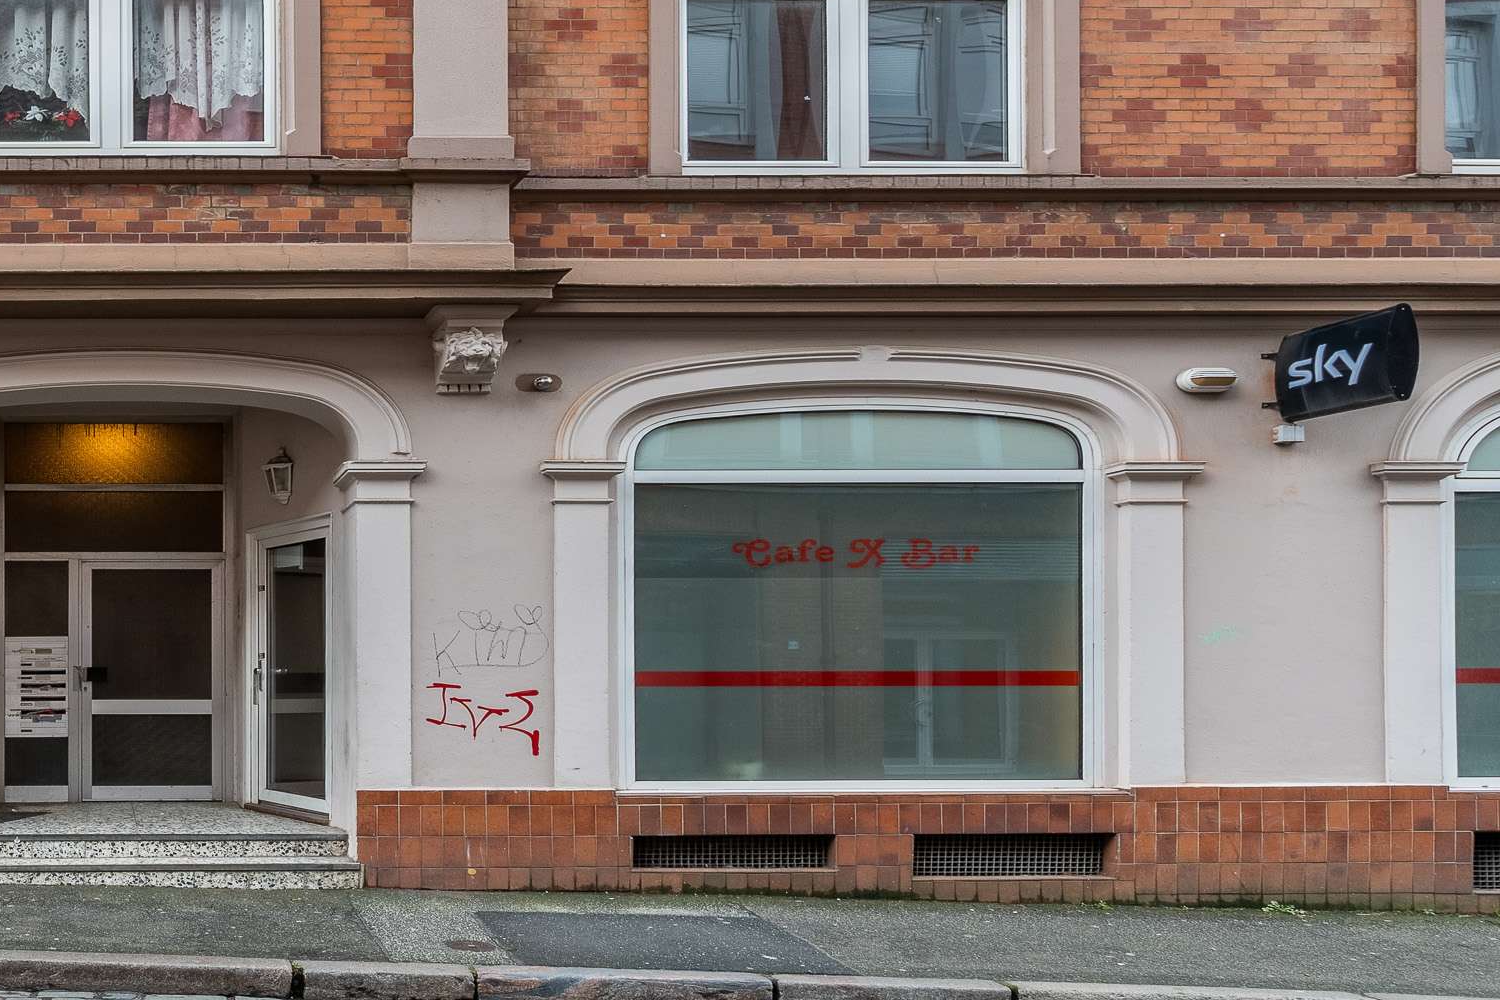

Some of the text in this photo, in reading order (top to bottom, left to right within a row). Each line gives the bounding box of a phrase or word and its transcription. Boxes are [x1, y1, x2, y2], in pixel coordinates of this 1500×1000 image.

[1288, 343, 1374, 389] sky
[732, 538, 835, 568] Cafe
[900, 538, 980, 569] Bar
